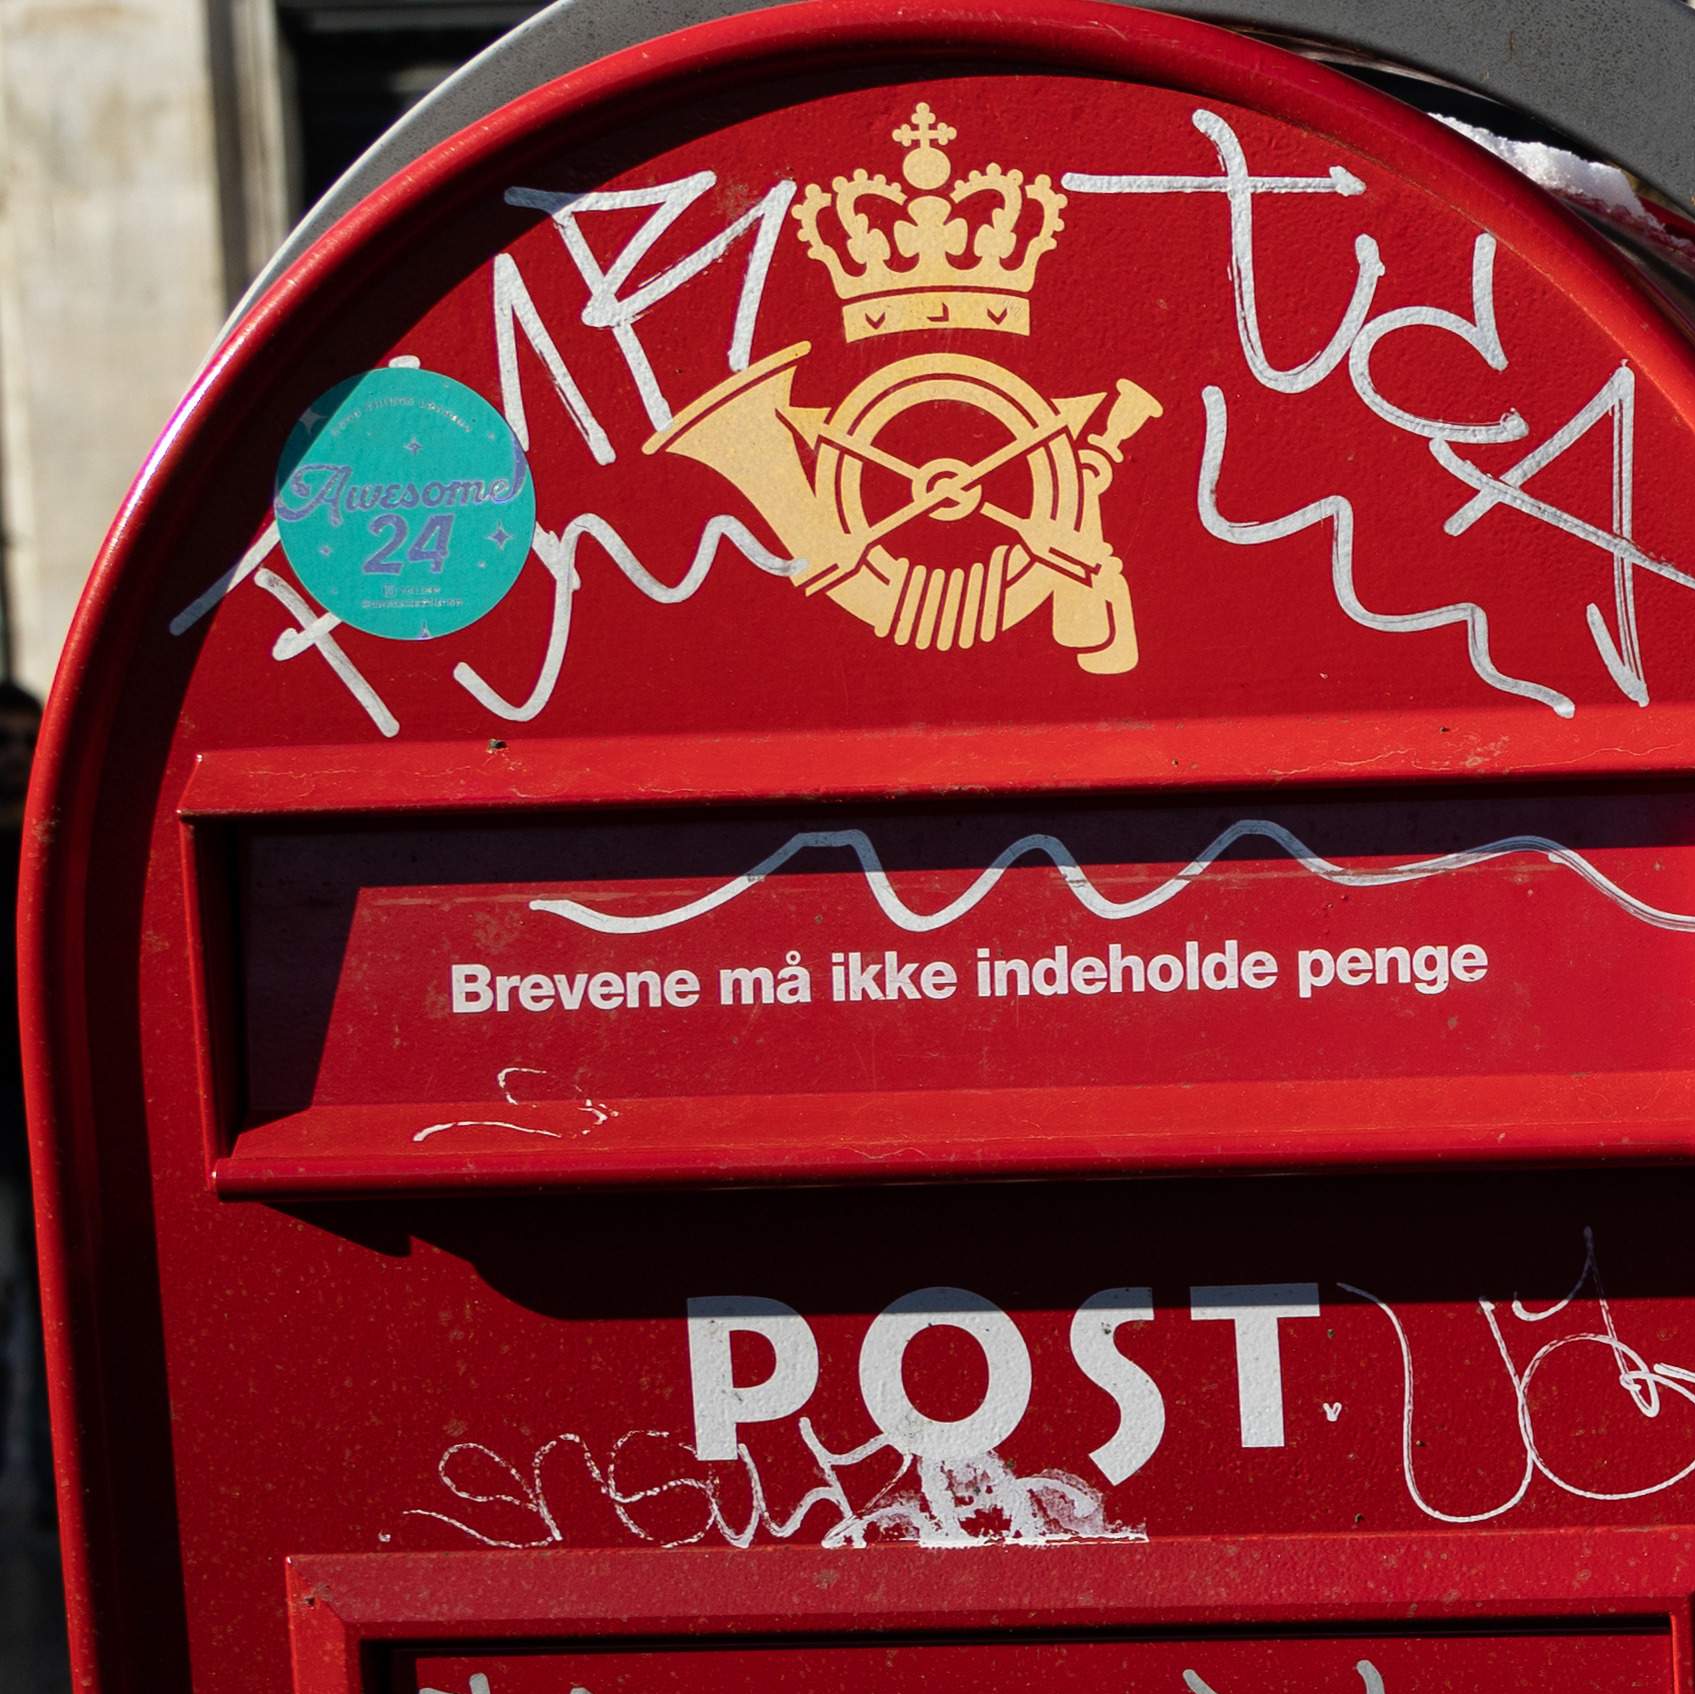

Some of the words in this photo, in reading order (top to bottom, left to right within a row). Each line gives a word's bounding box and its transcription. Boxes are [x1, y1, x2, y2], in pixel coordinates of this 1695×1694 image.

[274, 436, 527, 527] Awesome
[362, 513, 455, 576] 24
[451, 963, 700, 1014] Brevene
[720, 951, 811, 1006] må
[831, 951, 957, 1003] ikke
[977, 940, 1278, 999] indeholde
[1298, 943, 1488, 998] penge
[687, 1282, 1320, 1486] POST
